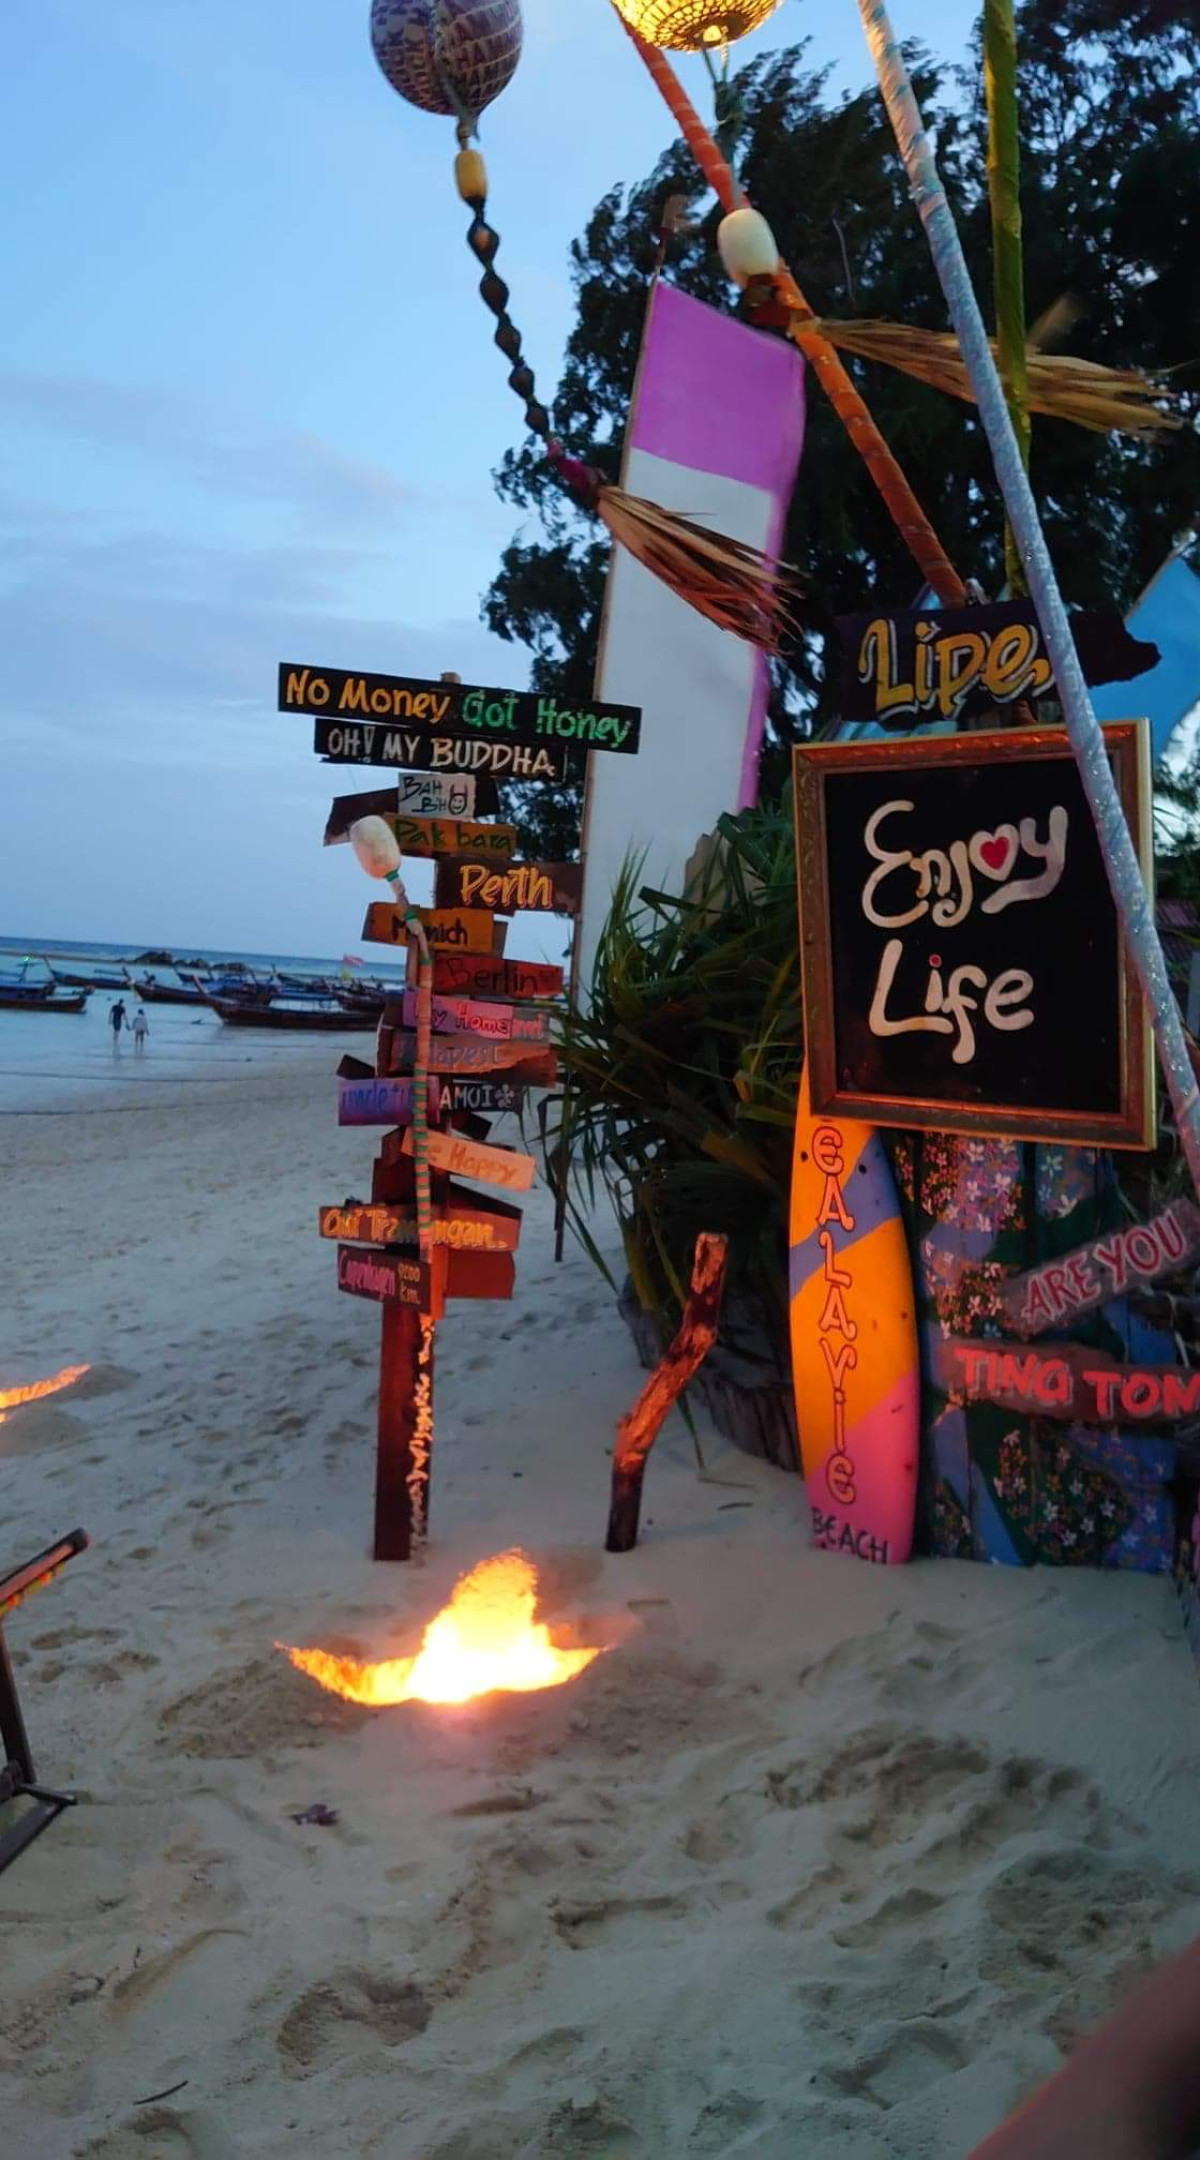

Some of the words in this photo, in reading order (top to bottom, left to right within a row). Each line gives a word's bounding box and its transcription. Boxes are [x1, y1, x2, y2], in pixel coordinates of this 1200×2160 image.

[285, 670, 330, 706] No
[338, 678, 450, 724] Money
[461, 690, 519, 730] Got
[537, 698, 632, 748] Honey
[382, 733, 420, 763] MY
[430, 737, 556, 776] BUDDHA
[395, 819, 446, 849] Pak
[460, 865, 553, 909] Perth
[861, 800, 1069, 928] Enjoy
[391, 915, 469, 945] Mnich
[437, 957, 538, 993] Berlin
[868, 940, 1035, 1064] Life
[1021, 1268, 1098, 1322] ARE
[1096, 1212, 1186, 1288] YOU
[954, 1348, 1072, 1403] TING
[810, 1505, 890, 1566] BEACH
